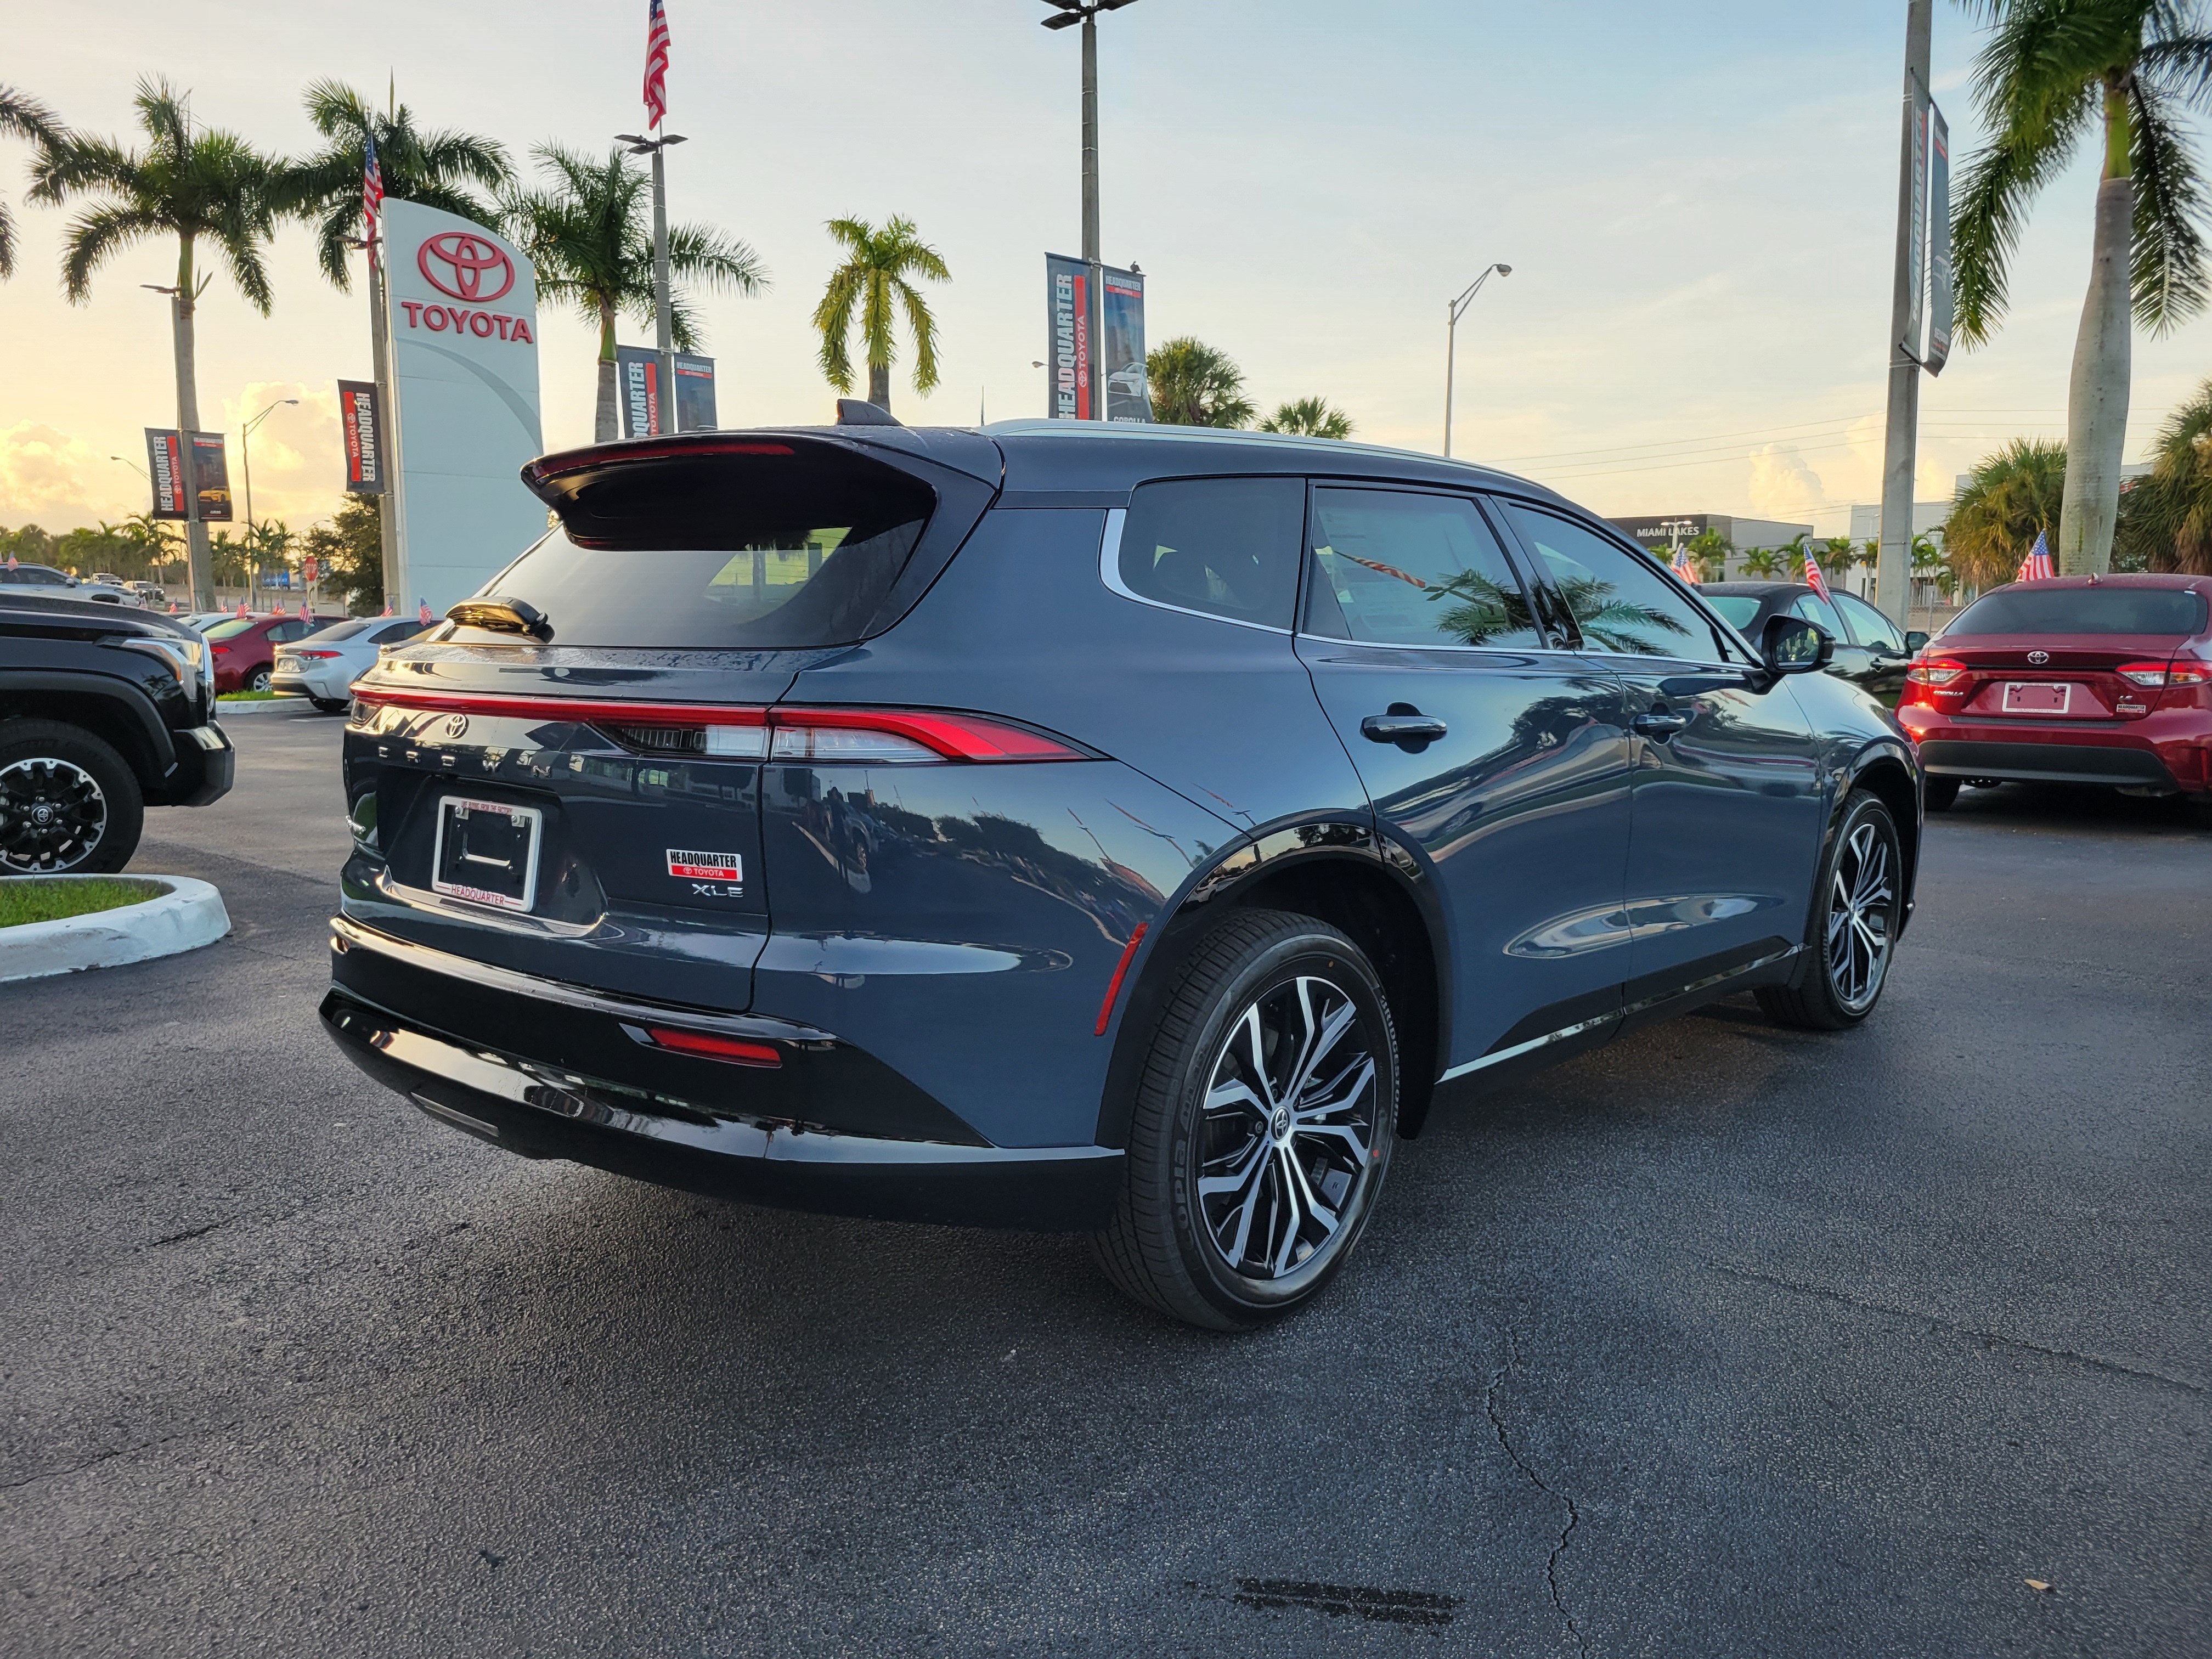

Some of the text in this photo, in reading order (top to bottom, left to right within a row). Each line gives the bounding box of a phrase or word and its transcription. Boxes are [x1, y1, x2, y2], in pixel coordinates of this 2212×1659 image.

[401, 301, 534, 344] TOYOTA
[1056, 274, 1076, 420] HEADQUARTER
[1077, 315, 1086, 369] TOYOTA
[648, 393, 657, 433] TOYOTA
[349, 425, 359, 458] TOYOTA
[356, 392, 376, 482] HEADQUARTER
[153, 436, 174, 511] HEADQUARTER
[1637, 527, 1667, 537] MIAMI
[306, 563, 317, 573] STOP
[670, 851, 737, 868] HEADQUARTER
[693, 868, 724, 877] TOYOTA
[452, 884, 504, 905] HEADQUARTER
[691, 883, 744, 898] XLE
